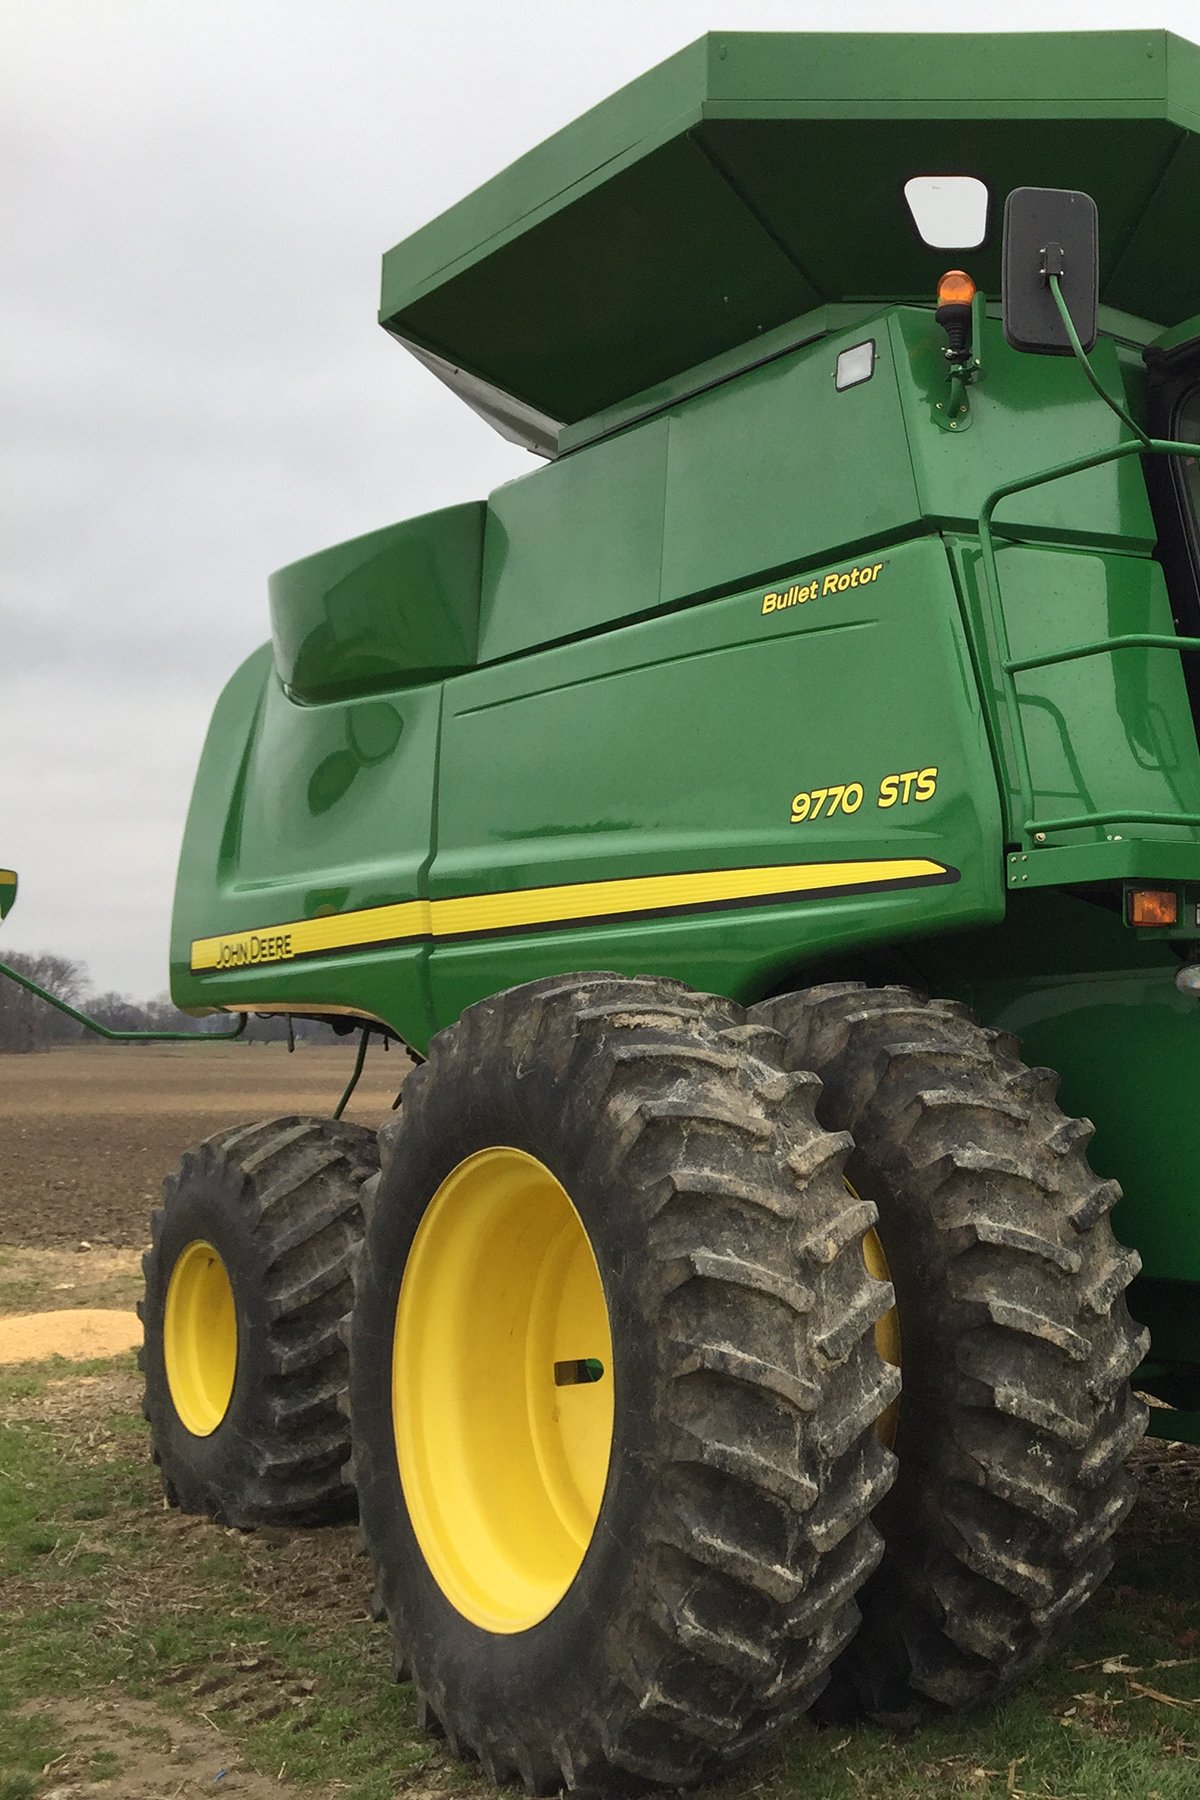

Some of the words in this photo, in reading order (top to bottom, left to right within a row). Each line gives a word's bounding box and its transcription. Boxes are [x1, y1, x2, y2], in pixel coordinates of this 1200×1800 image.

[761, 580, 819, 616] Bullet
[822, 562, 884, 597] Rotor
[790, 781, 864, 824] 9770
[878, 766, 939, 809] STS
[216, 941, 249, 966] JOHN
[250, 933, 293, 961] DEERE
